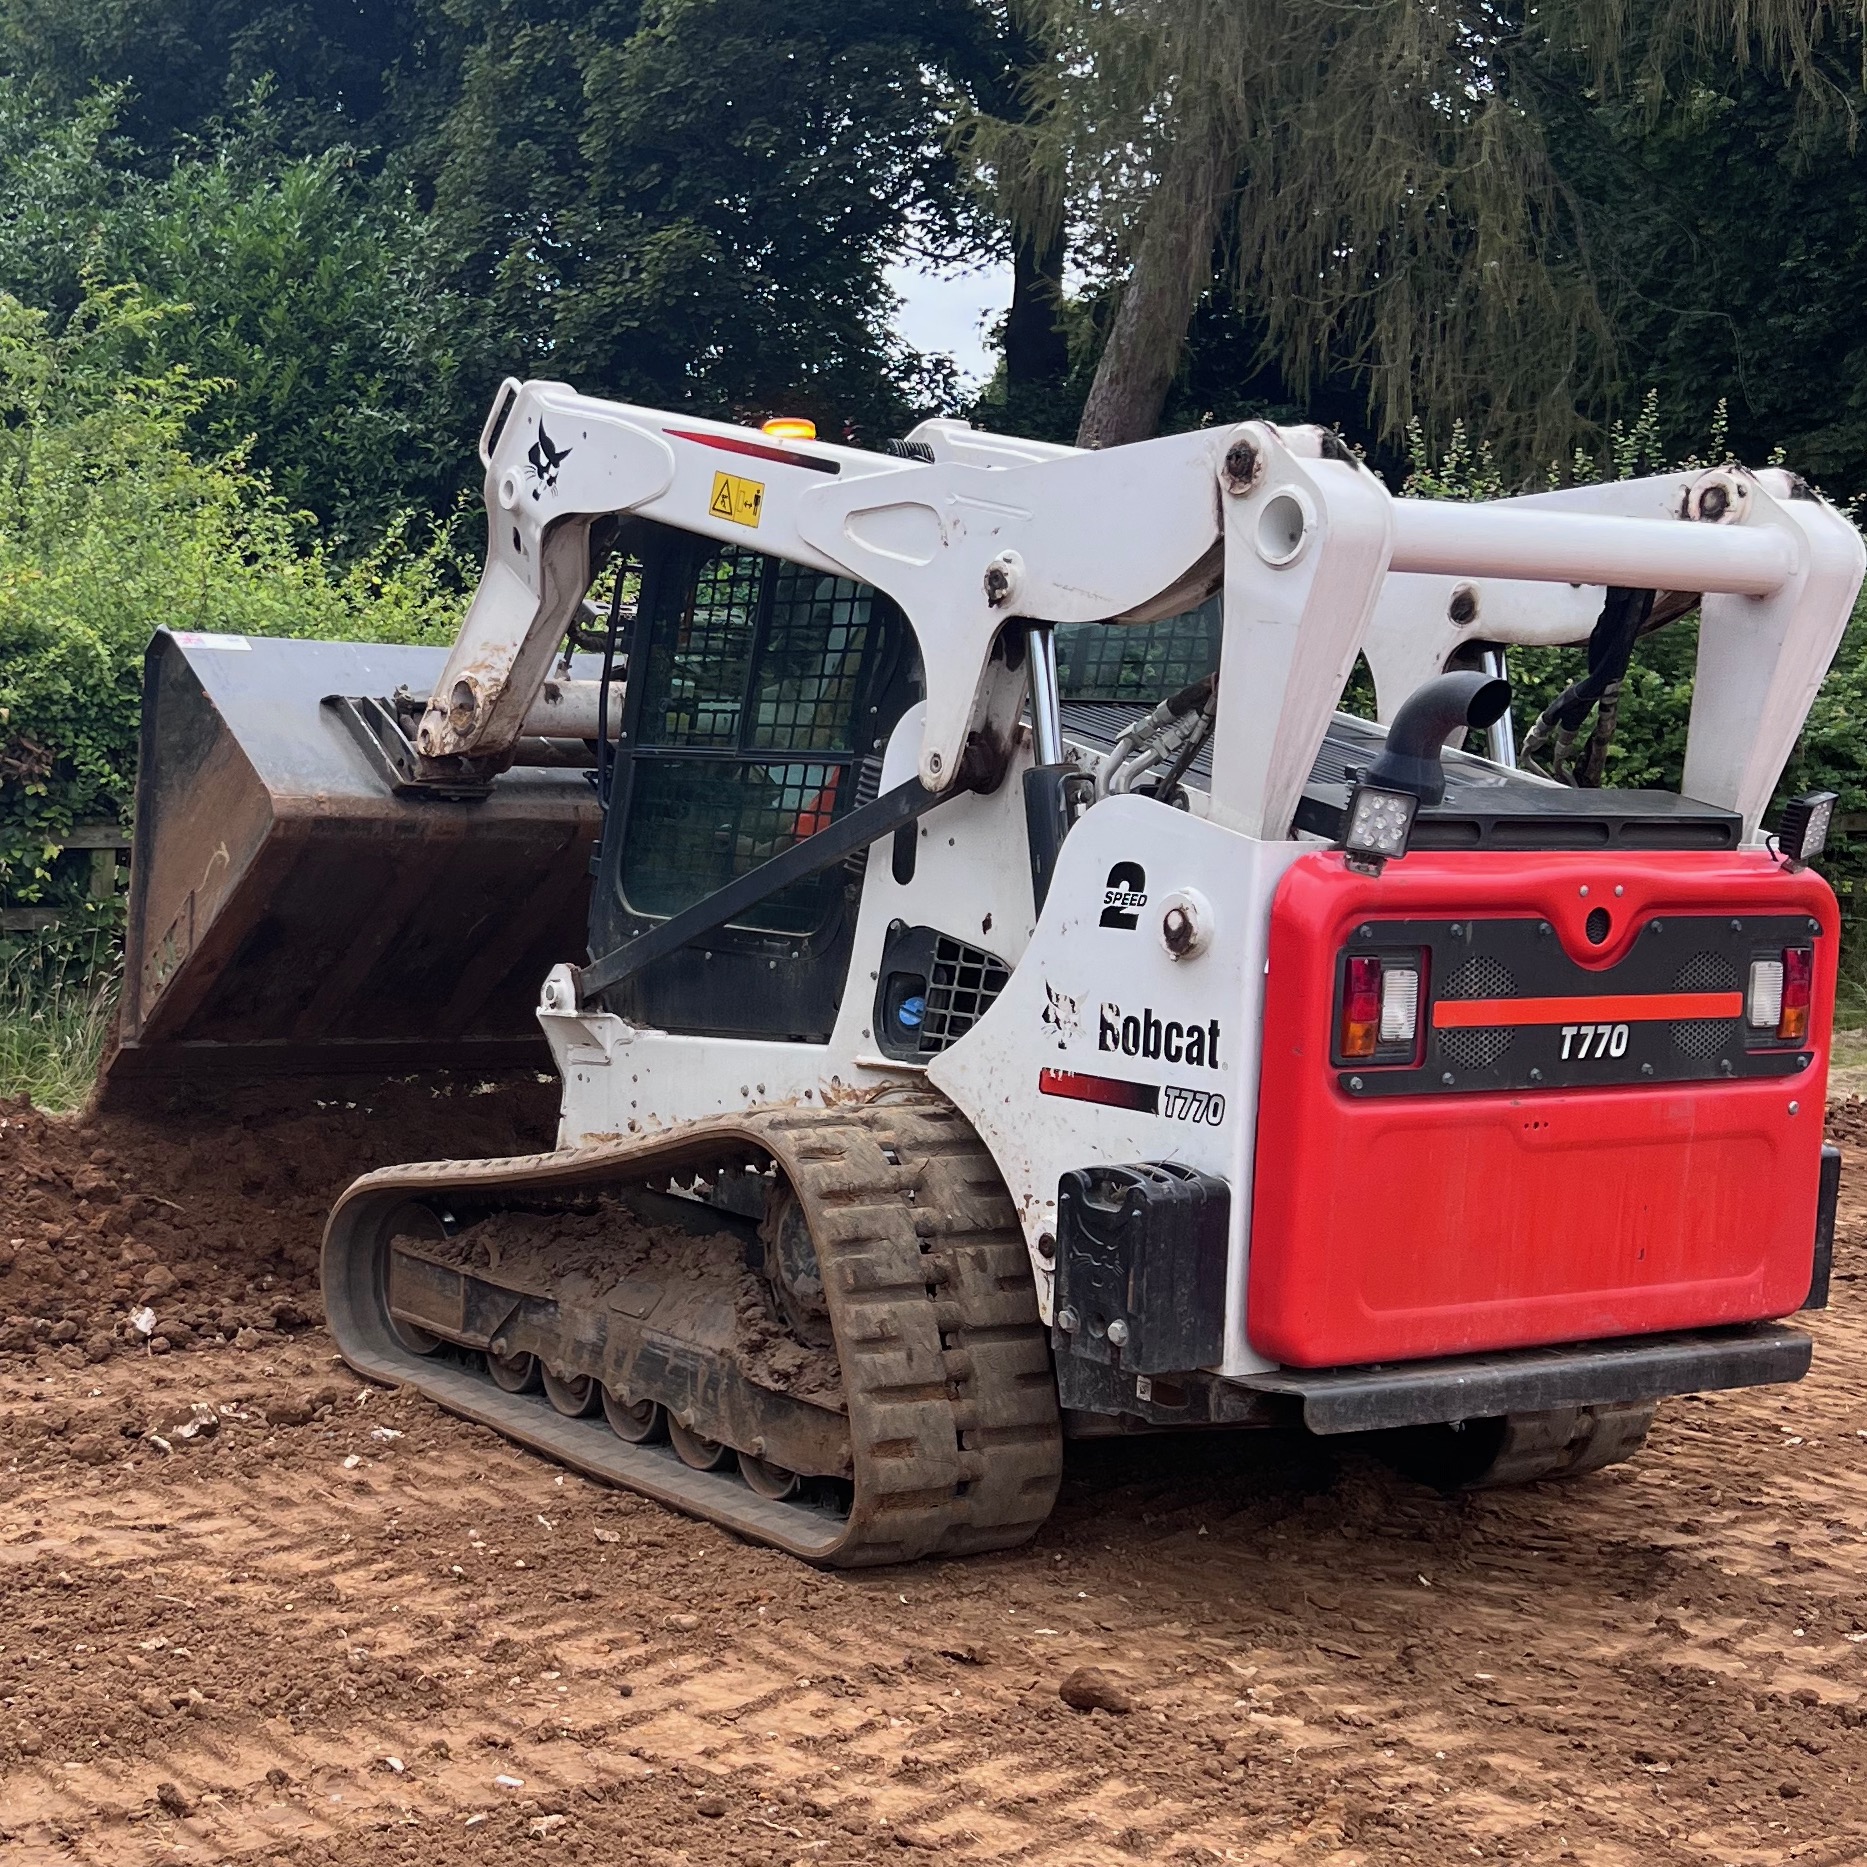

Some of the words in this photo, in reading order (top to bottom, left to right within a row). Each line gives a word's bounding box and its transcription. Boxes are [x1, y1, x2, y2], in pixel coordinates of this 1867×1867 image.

[1099, 861, 1145, 930] 2
[1103, 890, 1148, 907] SPEED
[1560, 1024, 1629, 1060] T770
[1164, 1085, 1226, 1126] T770
